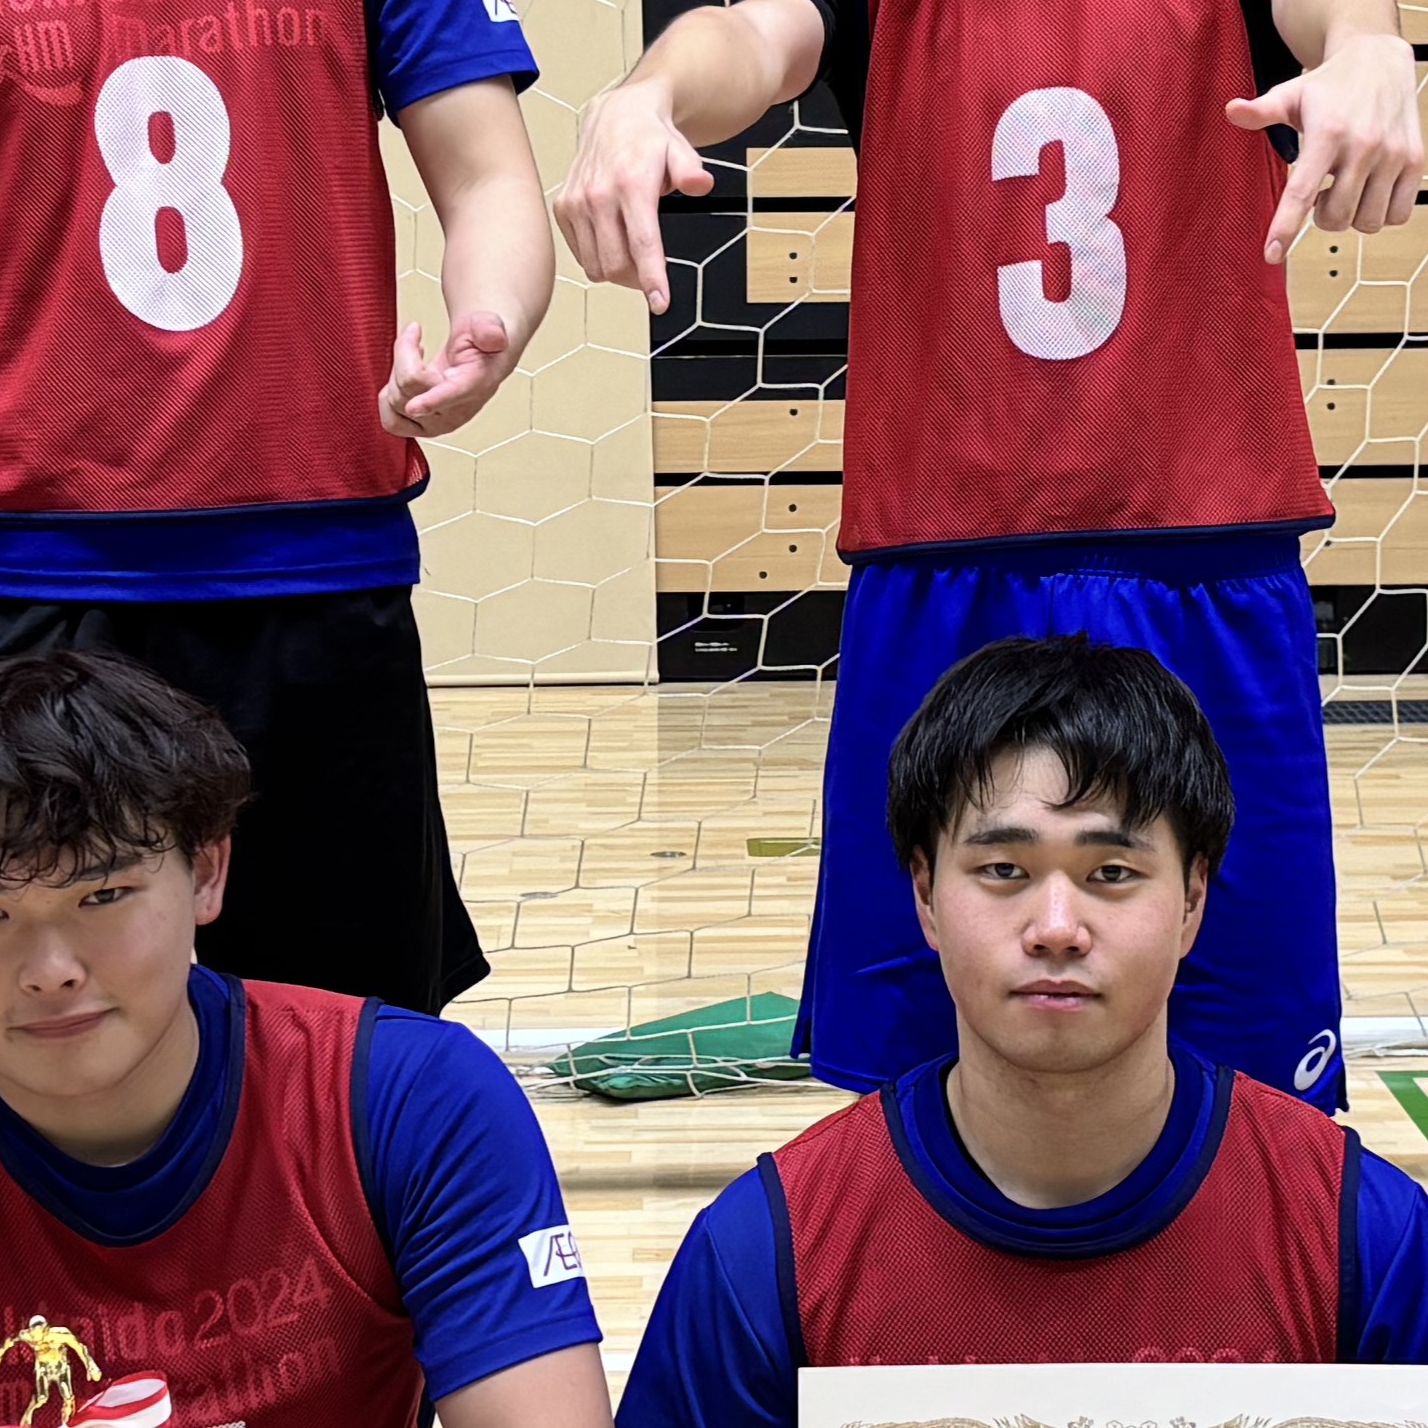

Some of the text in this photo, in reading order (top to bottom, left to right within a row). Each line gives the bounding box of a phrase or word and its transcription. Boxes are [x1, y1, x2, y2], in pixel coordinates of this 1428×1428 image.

[94, 56, 244, 332] 8
[991, 86, 1127, 360] 3
[194, 1253, 334, 1352] 2024
